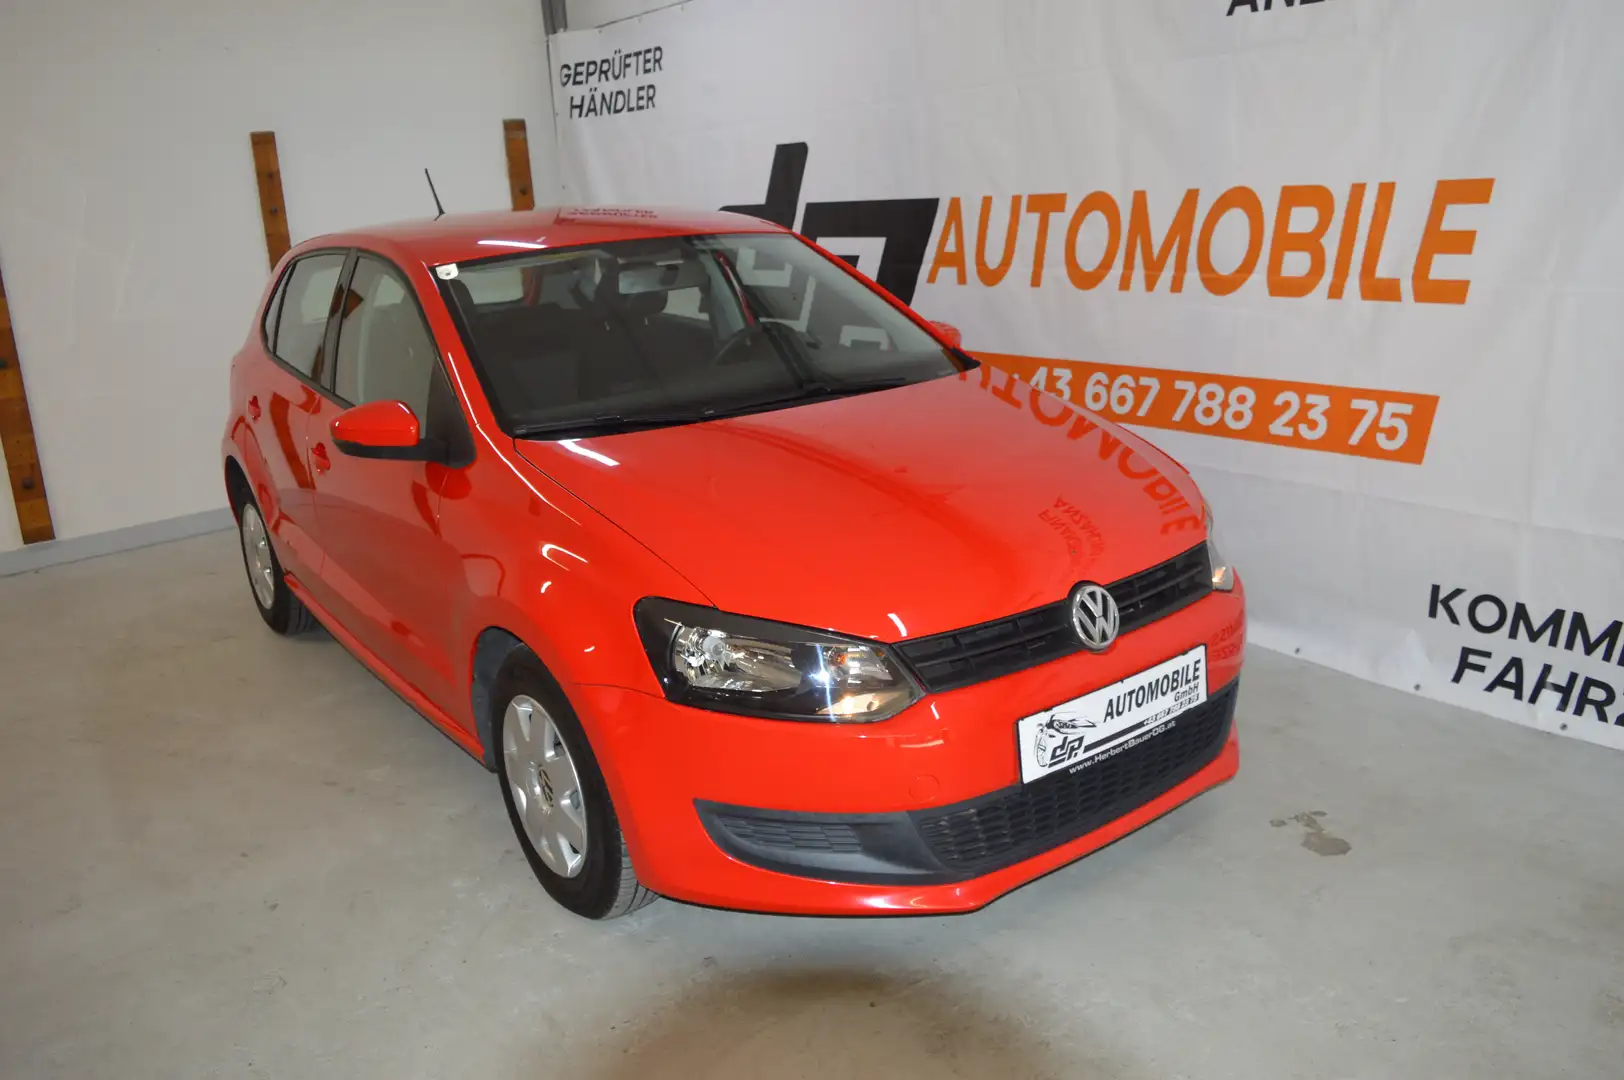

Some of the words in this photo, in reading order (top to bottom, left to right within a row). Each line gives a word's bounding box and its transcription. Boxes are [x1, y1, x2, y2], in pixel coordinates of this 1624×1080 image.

[560, 46, 663, 88] GEPRÜFTER
[569, 84, 657, 119] HÄNDLER
[927, 178, 1496, 305] AUTOMOBILE
[1084, 371, 1161, 417] 667
[1171, 380, 1257, 431] 788
[1268, 391, 1330, 441] 23
[1347, 399, 1414, 452] 75
[1103, 658, 1201, 723] AUTOMOBILE
[1174, 682, 1200, 702] GmbH
[1451, 646, 1624, 727] FAHR
[1069, 721, 1177, 775] www.HerbertBauerOG.at
